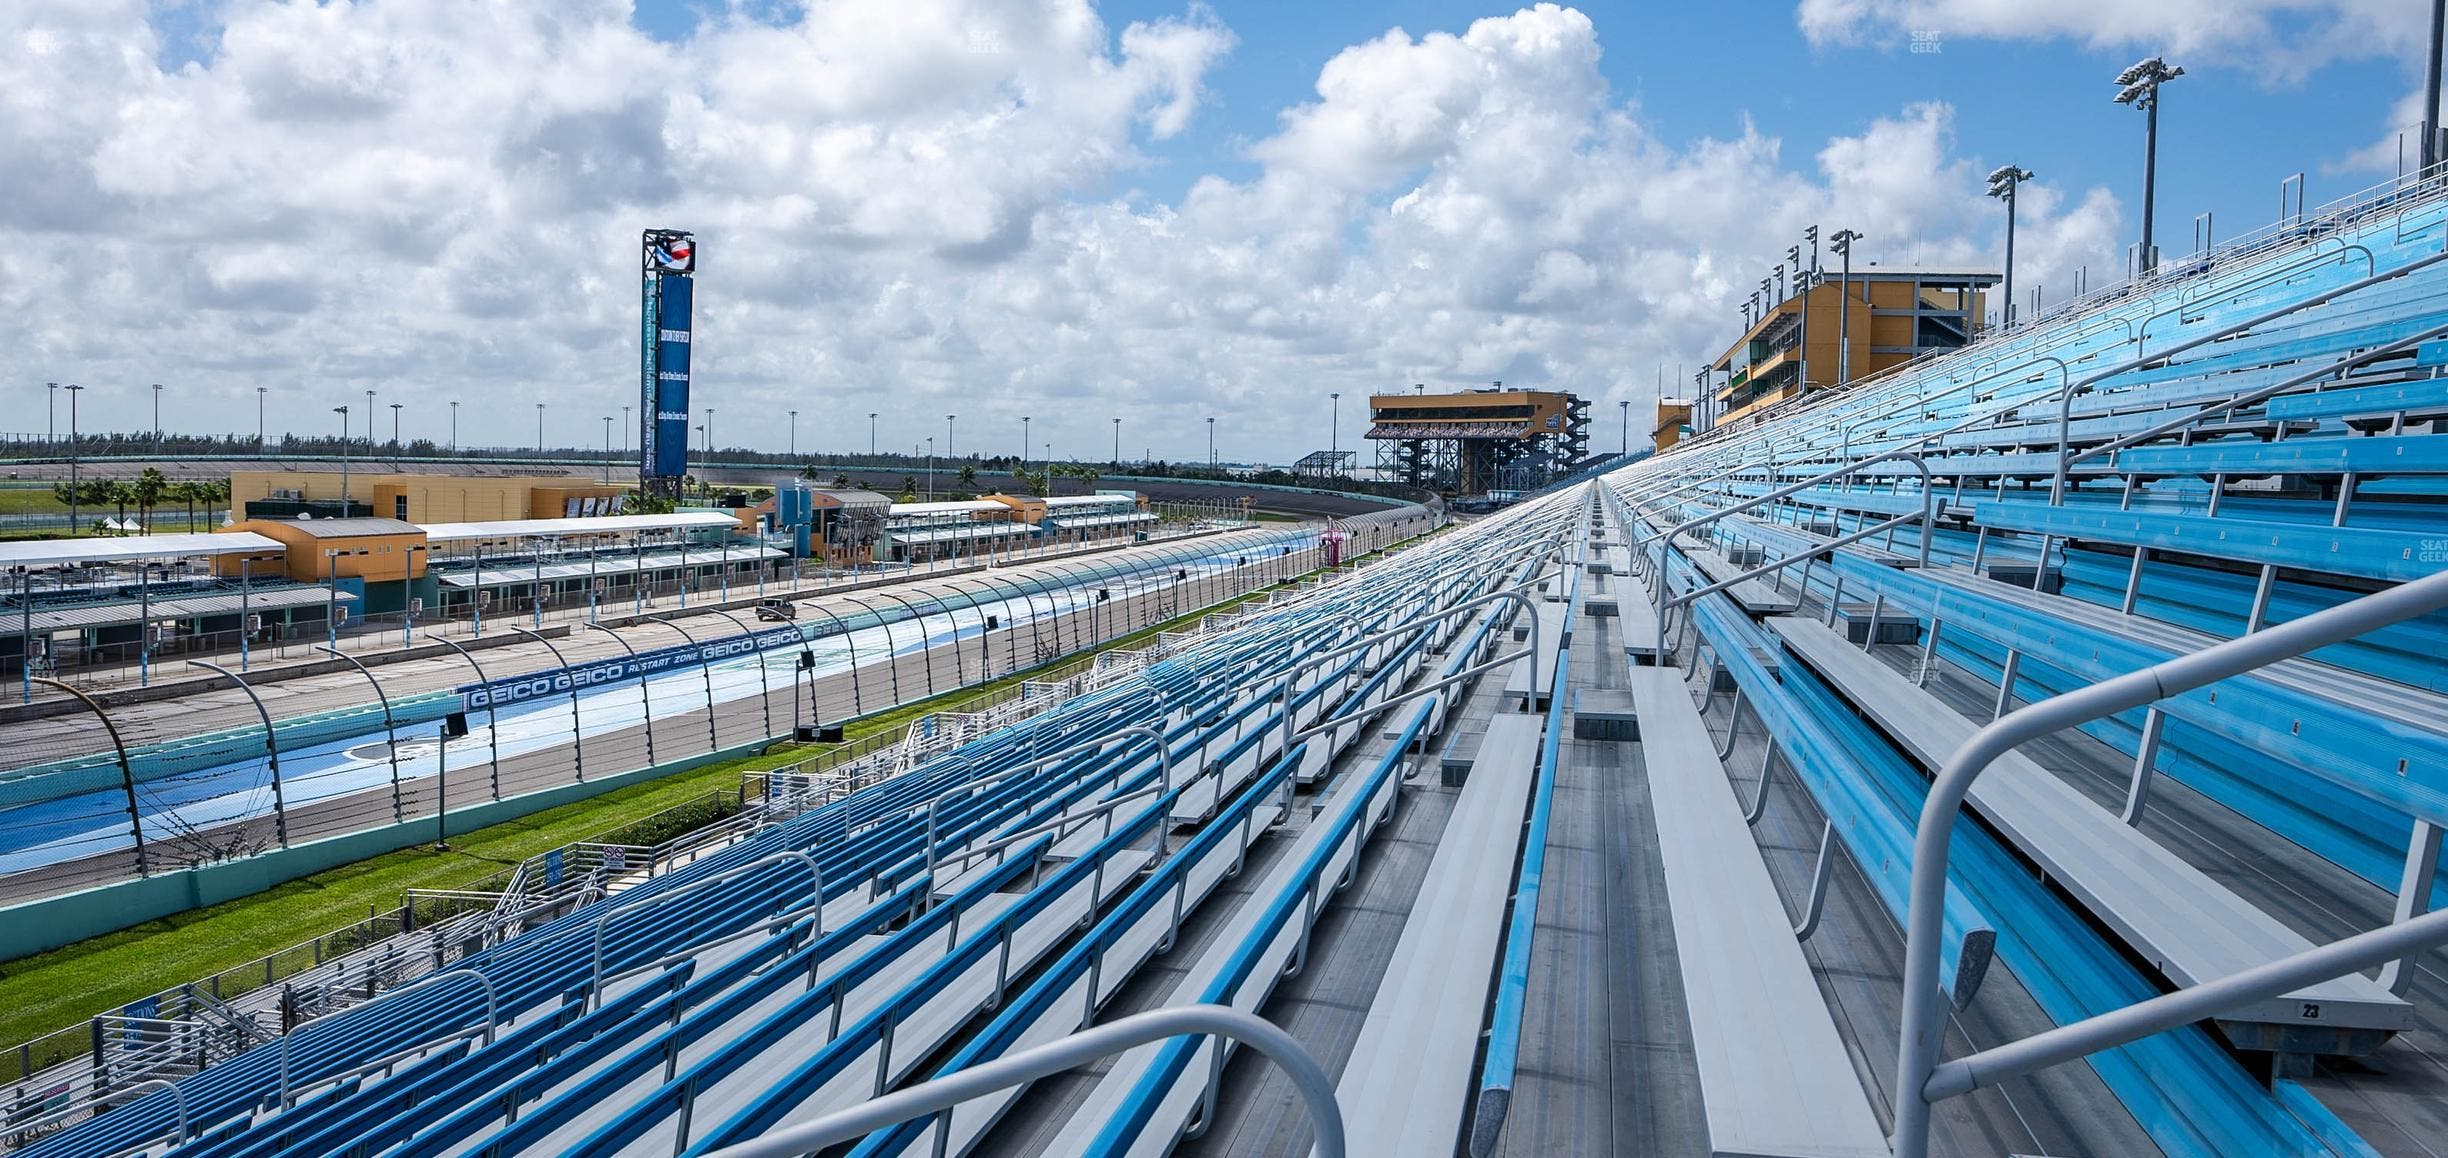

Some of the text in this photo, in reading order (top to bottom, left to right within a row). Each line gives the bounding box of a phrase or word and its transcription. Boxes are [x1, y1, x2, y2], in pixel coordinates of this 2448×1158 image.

[470, 631, 802, 708] GEICO GEICO RESTART ZONE GEICO GEICO
[2302, 1003, 2320, 1018] 23
